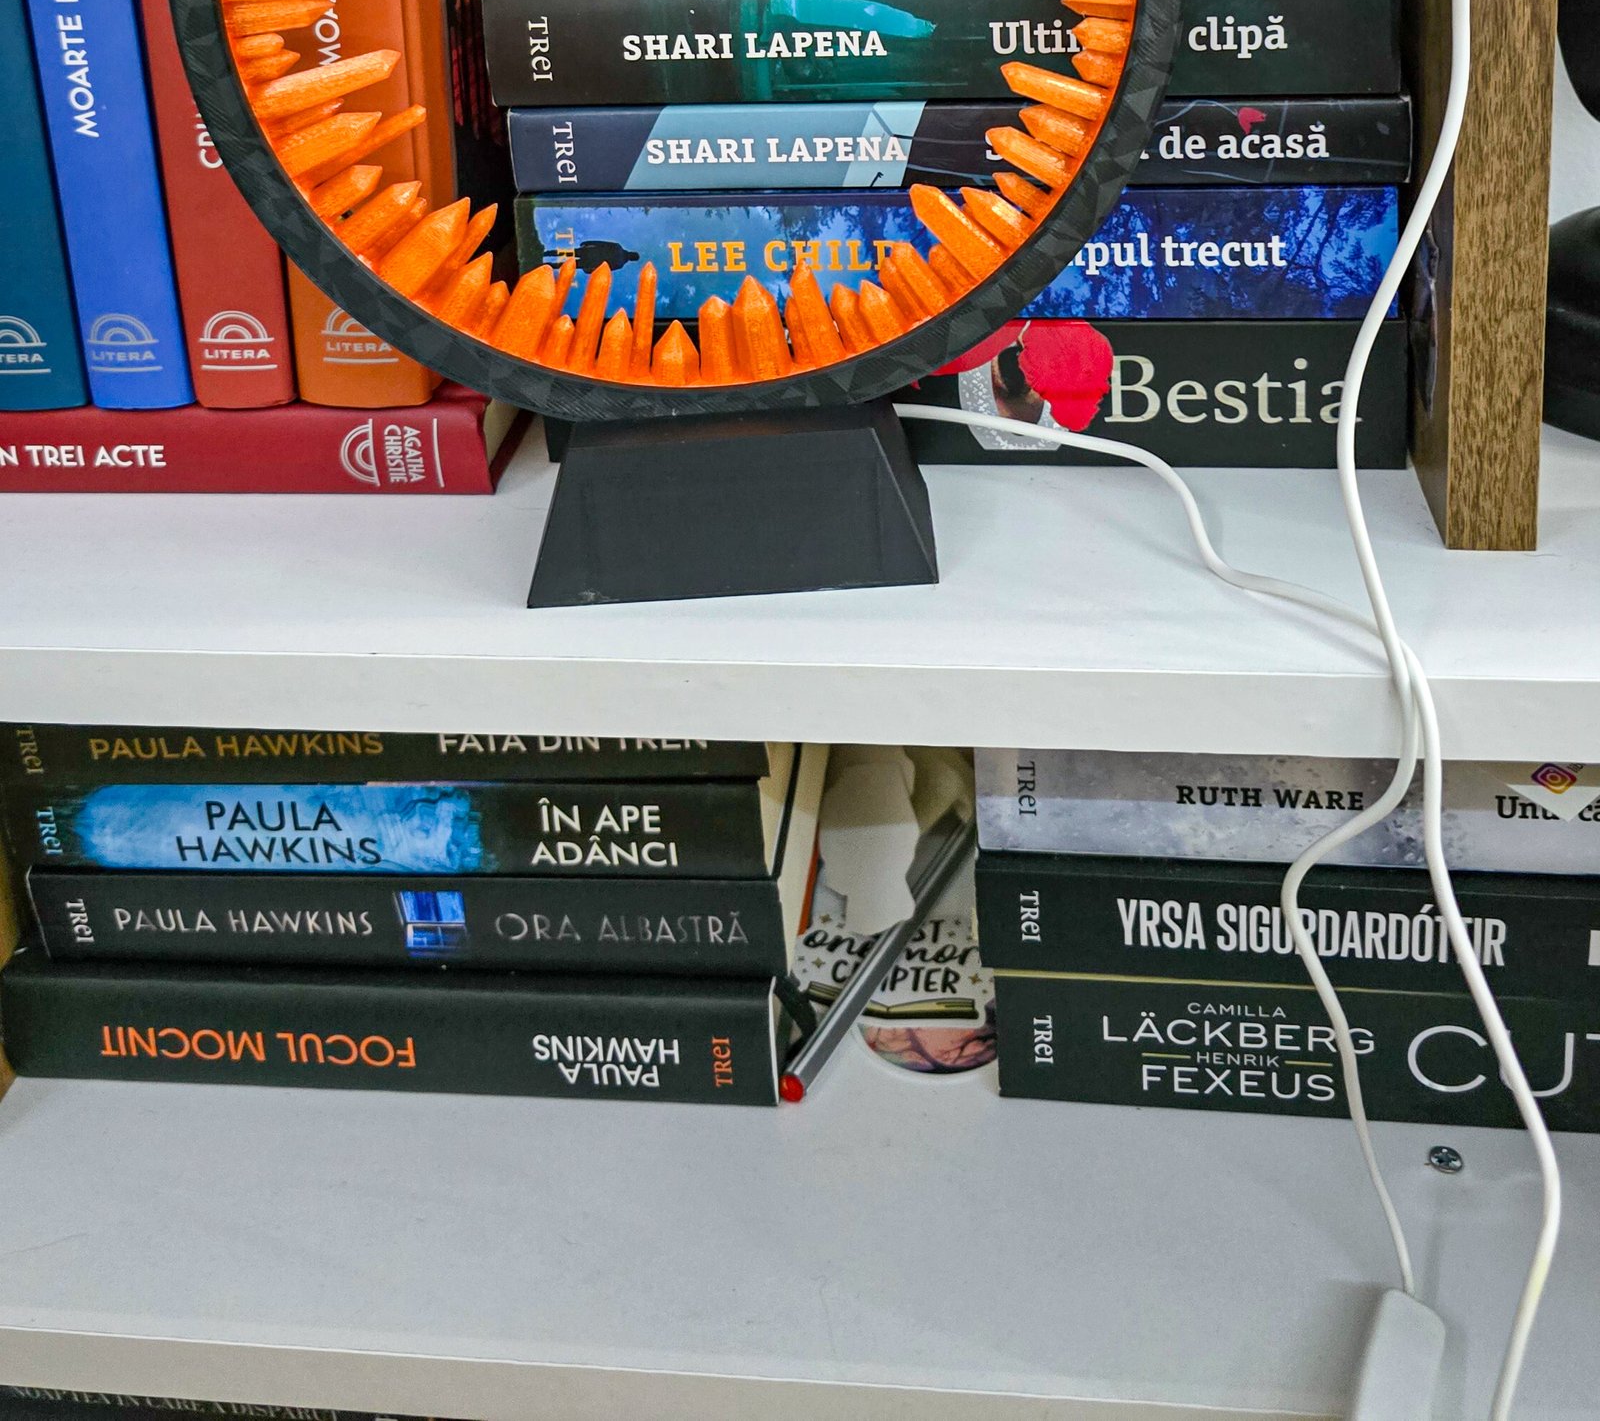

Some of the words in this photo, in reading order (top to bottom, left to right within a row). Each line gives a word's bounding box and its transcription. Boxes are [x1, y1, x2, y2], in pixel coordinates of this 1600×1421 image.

[623, 33, 734, 62] SHARI
[744, 30, 888, 59] LAPENA
[988, 19, 1087, 55] Ulti
[1188, 15, 1289, 59] clipă
[56, 14, 100, 138] MOARTE
[647, 138, 755, 165] SHARI
[767, 136, 908, 162] LAPENA
[1158, 125, 1206, 161] de
[1217, 124, 1330, 160] acasă
[668, 241, 746, 273] LEE
[1065, 232, 1153, 276] pul
[1161, 235, 1287, 268] trecut
[91, 350, 156, 362] LITERA
[204, 348, 271, 359] LITERA
[325, 341, 393, 353] LITERA
[1103, 354, 1363, 425] Bestia
[24, 445, 86, 467] TREI
[94, 445, 167, 467] ACTE
[384, 424, 407, 484] CHRISTIE
[403, 425, 426, 483] AGATHA
[89, 735, 206, 761] PAULA
[215, 732, 384, 759] HAWKINS
[1176, 784, 1263, 808] RUTH
[1273, 787, 1364, 812] WARE
[206, 801, 342, 832] PAULA
[538, 797, 580, 833] ÎN
[593, 804, 662, 834] APE
[176, 835, 383, 866] HAWKINS
[531, 833, 678, 867] ADÂNCI
[113, 907, 217, 933] PAULA
[228, 909, 374, 936] HAWKINS
[495, 912, 582, 942] ORA
[599, 911, 748, 945] ALBASTRĂ
[1116, 898, 1206, 950] YRSA
[1216, 902, 1507, 967] SIGUDARDÓTIR
[831, 958, 961, 994] CPTER
[1187, 1002, 1287, 1020] CAMILLA
[101, 1025, 266, 1062] MOCNIT
[533, 1034, 680, 1065] HAWKINS
[1102, 1010, 1376, 1056] LÄCKBERG
[277, 1032, 416, 1068] FOCUL
[1195, 1052, 1280, 1068] HENRIK
[561, 1061, 660, 1088] PAULA
[1141, 1066, 1336, 1103] FEXEUS
